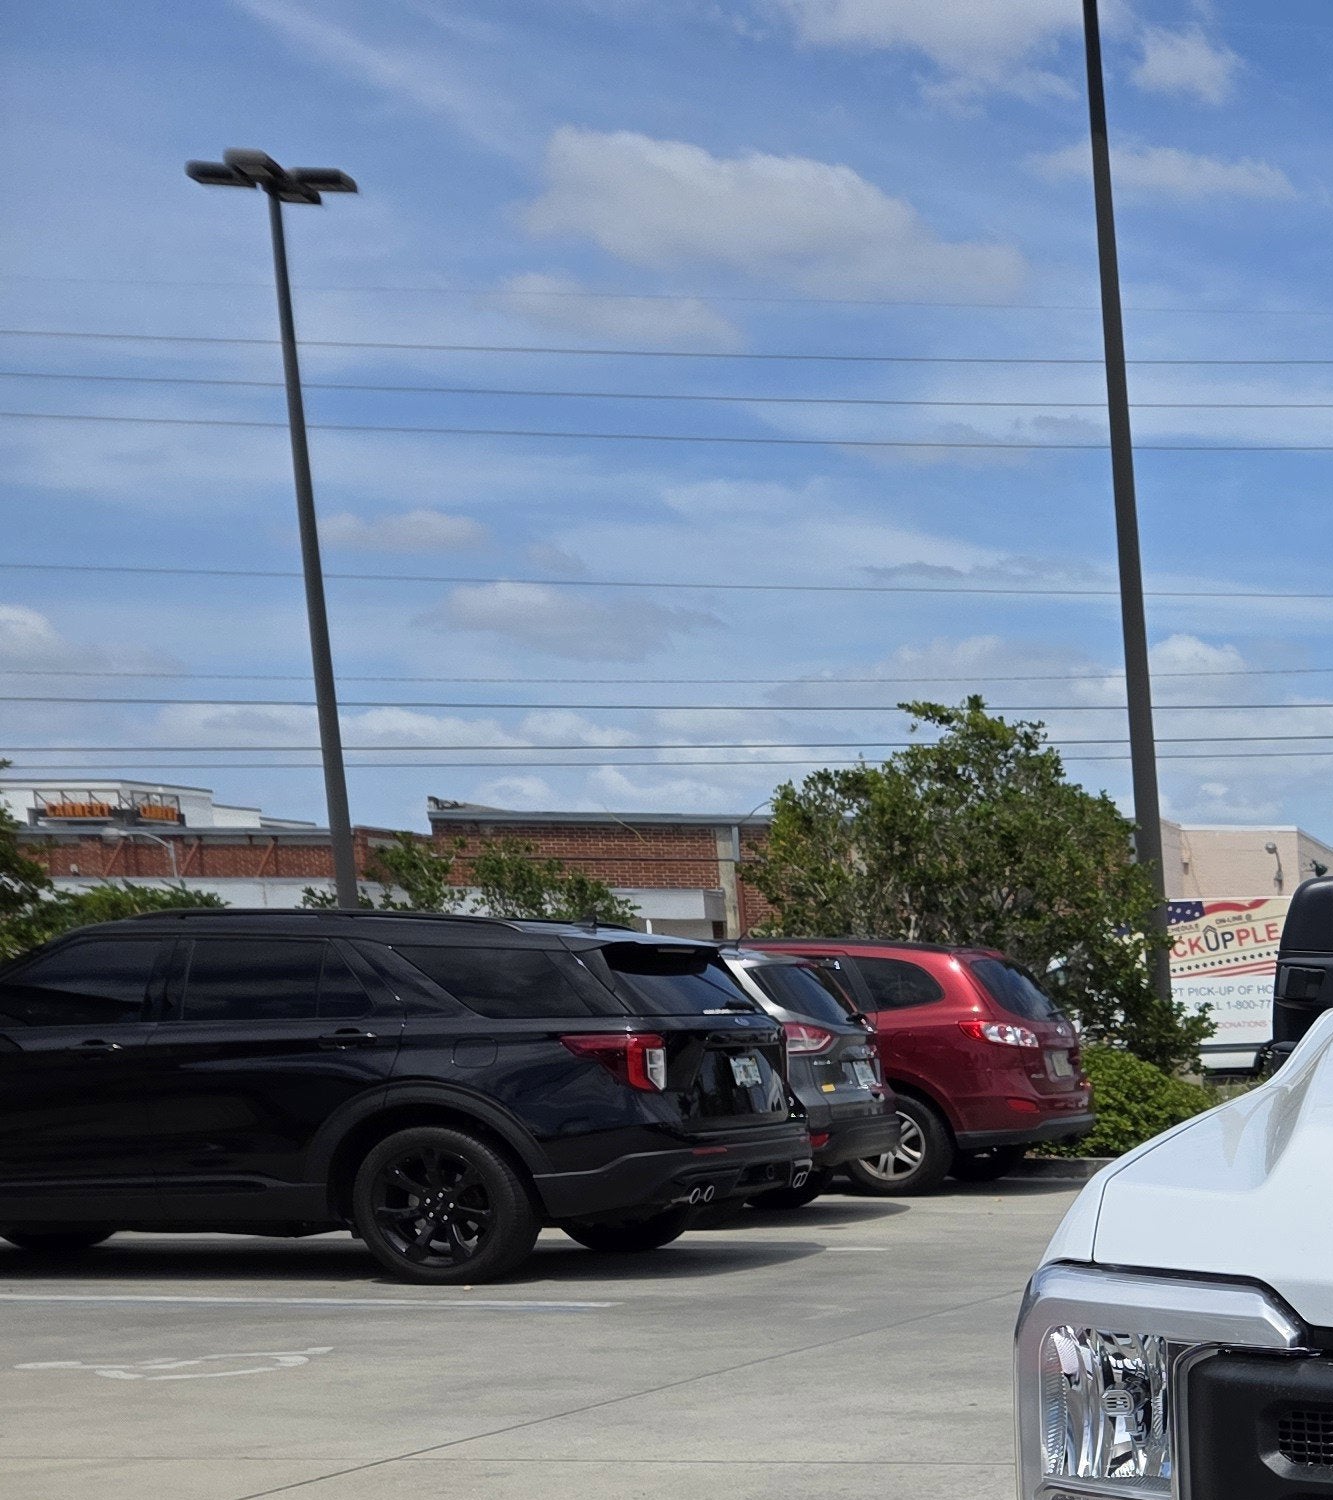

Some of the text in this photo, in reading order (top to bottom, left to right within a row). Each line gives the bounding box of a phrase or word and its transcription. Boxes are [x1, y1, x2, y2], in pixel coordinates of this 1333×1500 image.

[1188, 986, 1235, 997] PICK-UP
[1238, 984, 1254, 995] OF
[1226, 1000, 1272, 1010] 1-800-77
